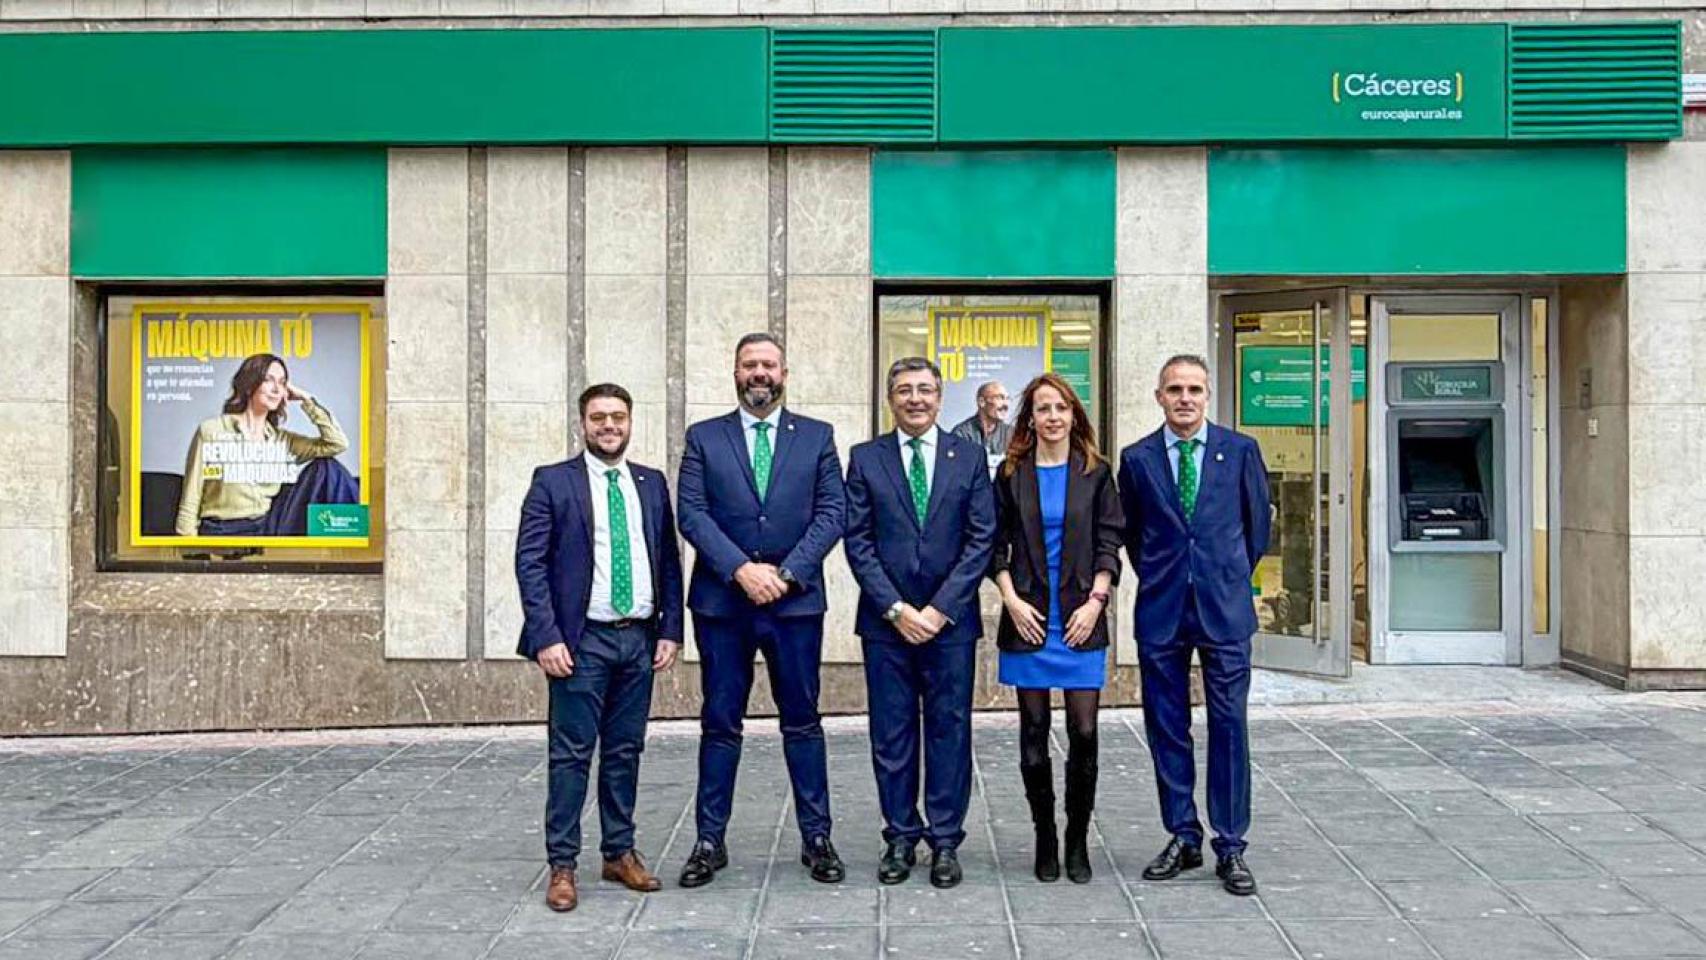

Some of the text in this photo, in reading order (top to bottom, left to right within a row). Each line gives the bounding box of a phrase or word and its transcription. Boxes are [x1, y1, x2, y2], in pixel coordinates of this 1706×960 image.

[147, 312, 313, 362] MÁQUINA TÚ
[940, 312, 1038, 350] MÁQUINA
[939, 345, 965, 382] TÚ
